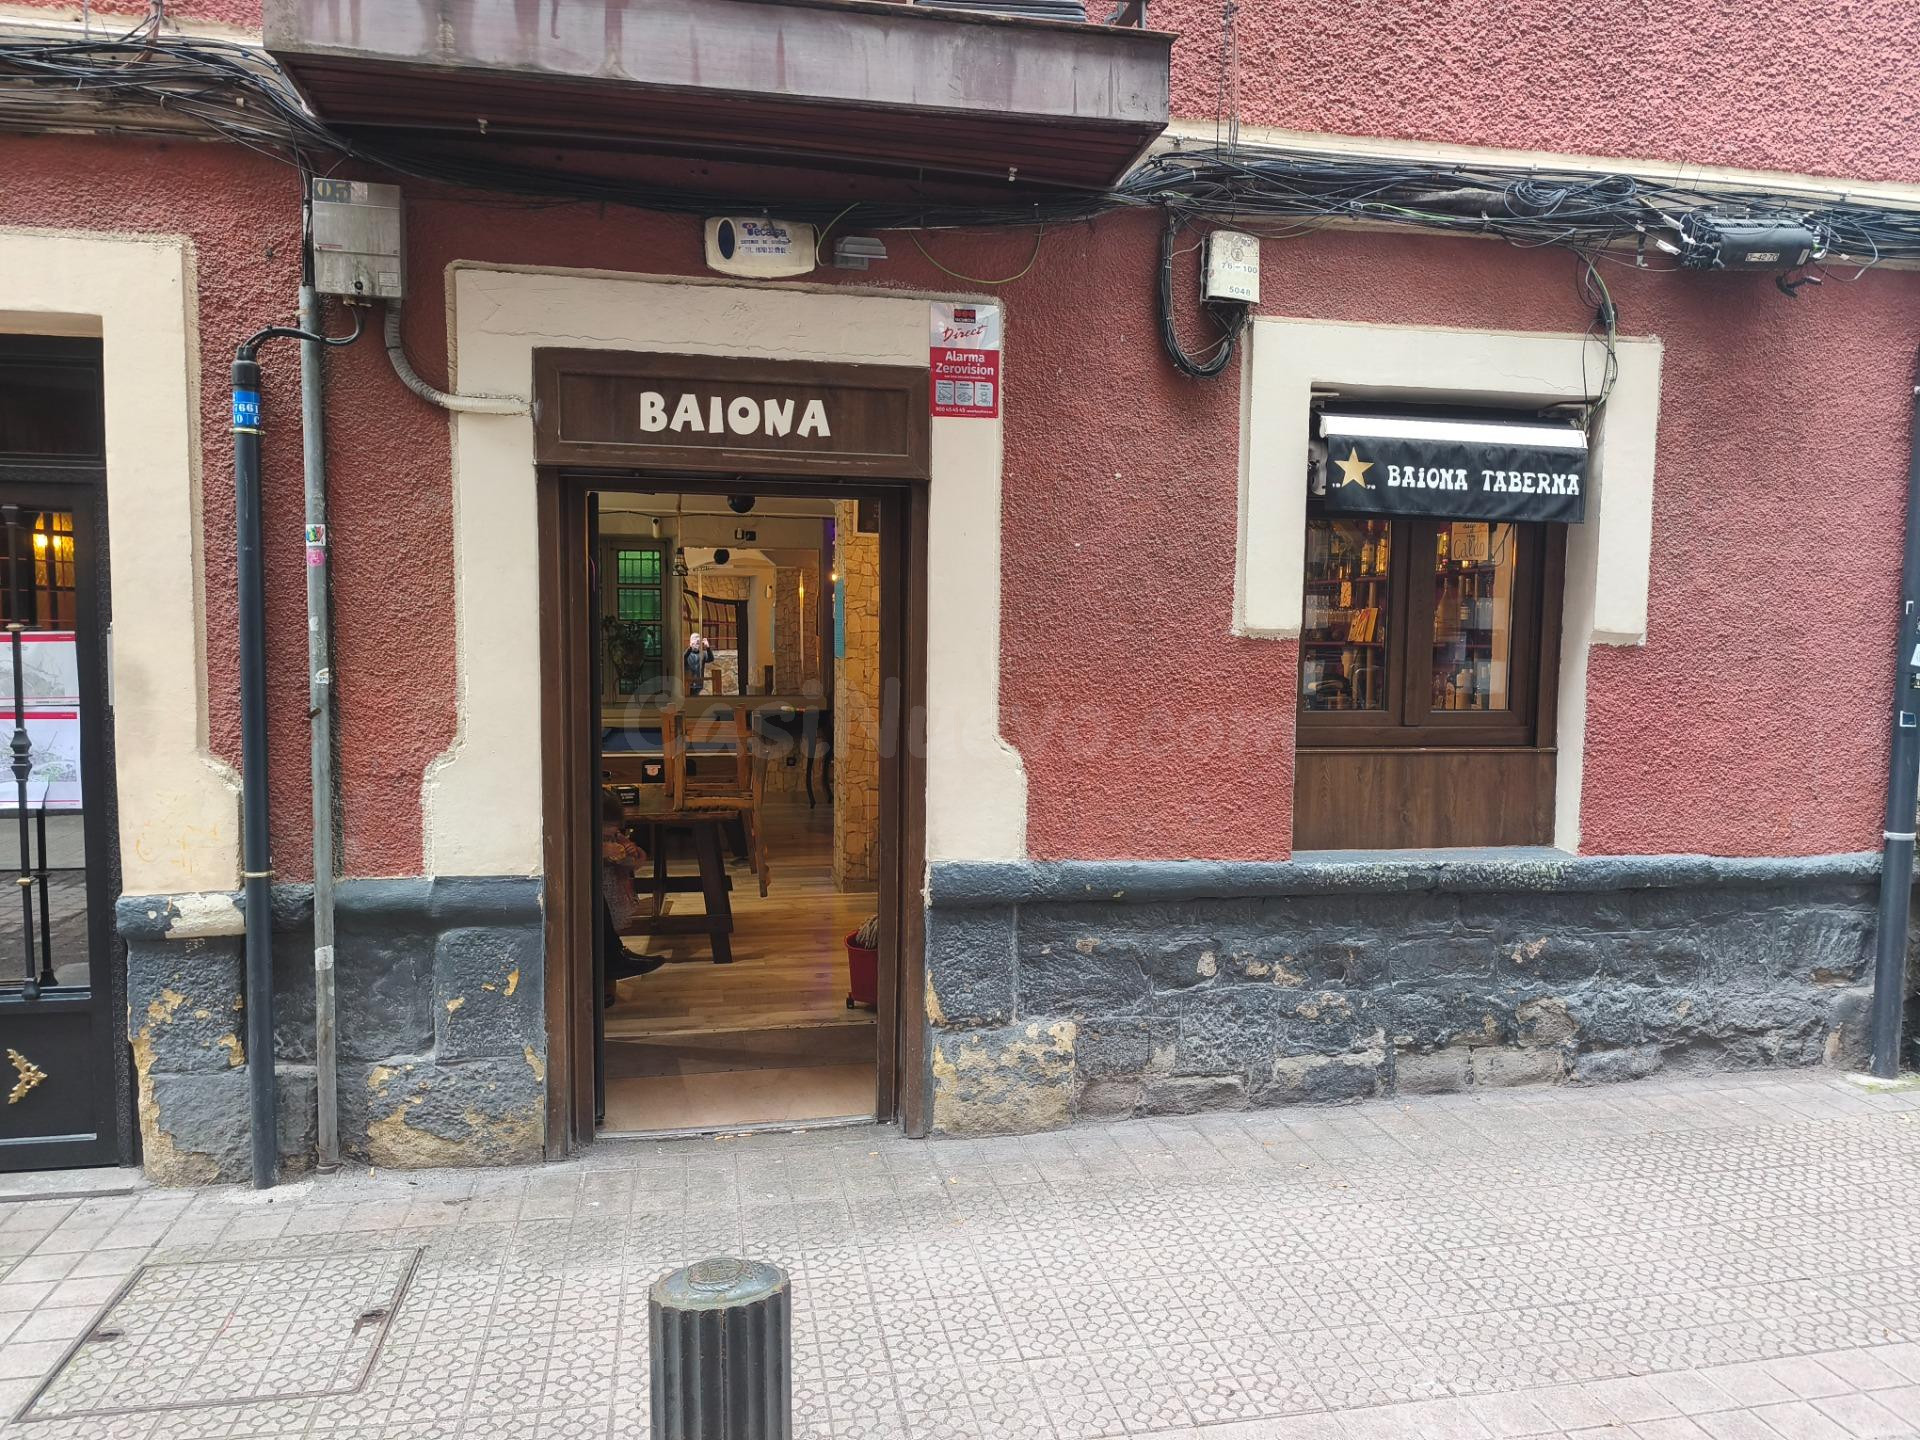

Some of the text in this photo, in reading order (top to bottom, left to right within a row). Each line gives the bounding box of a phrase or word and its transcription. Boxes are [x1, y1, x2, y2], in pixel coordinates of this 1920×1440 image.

[1229, 286, 1251, 296] 5048
[942, 324, 989, 342] Direct
[945, 351, 985, 362] Alarma
[935, 362, 994, 376] Zerovision
[640, 391, 831, 438] BAIONA
[1482, 470, 1580, 496] TABERNA
